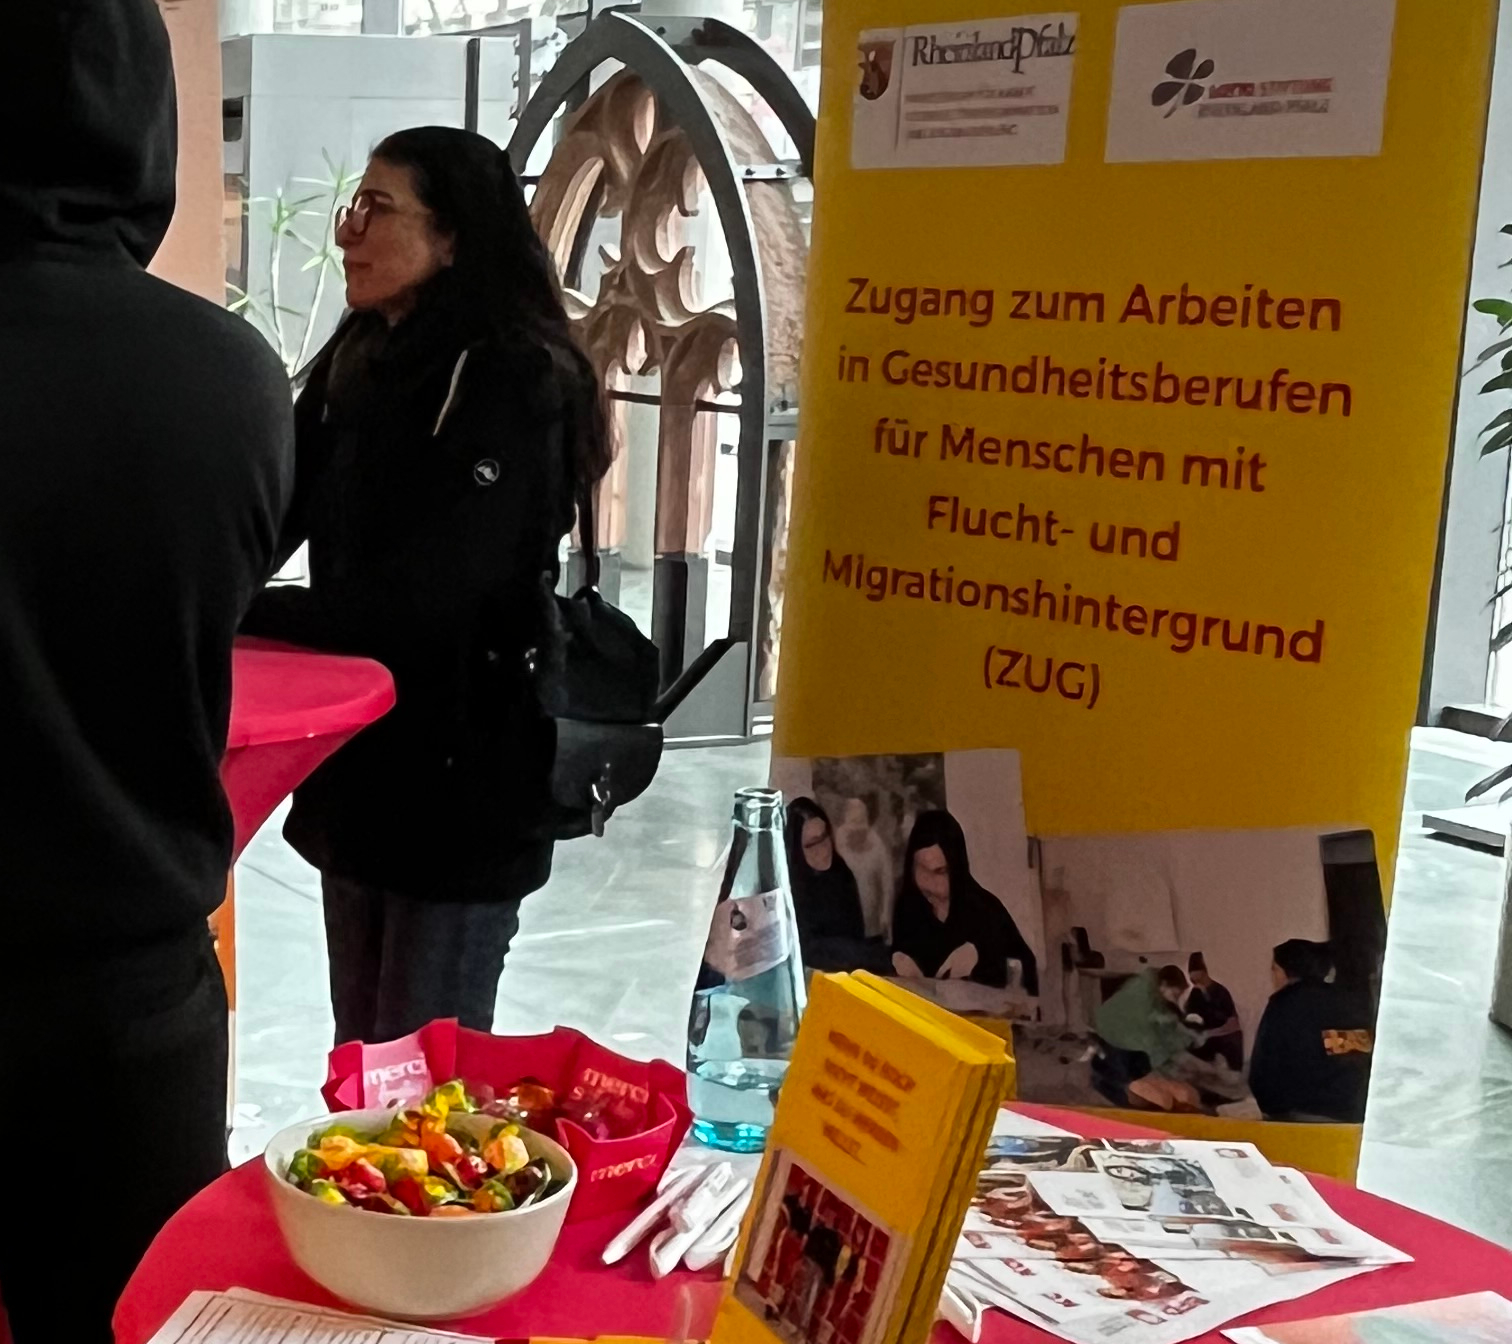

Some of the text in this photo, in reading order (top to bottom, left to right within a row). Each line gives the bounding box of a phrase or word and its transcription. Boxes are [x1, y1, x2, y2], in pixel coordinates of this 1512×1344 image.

[844, 277, 1342, 332] Zugang zum Arbeiten
[837, 345, 1353, 417] in Gesundheitsberufen
[874, 417, 1267, 492] für Menschen mit
[927, 495, 1181, 561] Flucht- und
[822, 549, 1325, 663] Migrationshintergrund
[983, 645, 1101, 709] (ZUG)
[590, 1154, 658, 1184] merci
